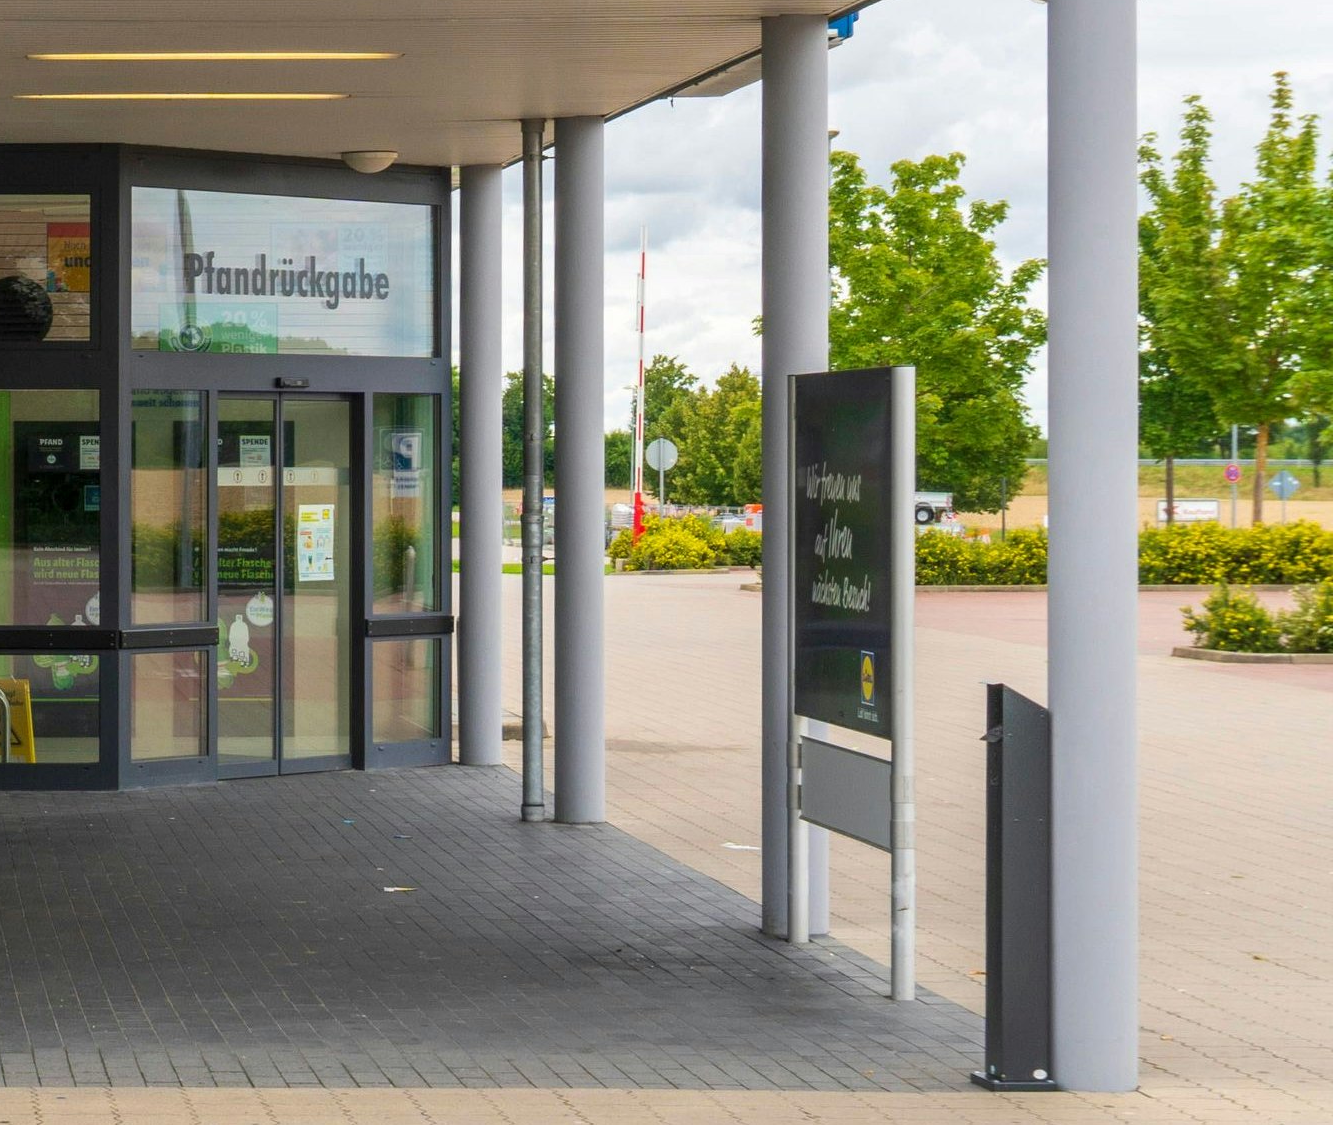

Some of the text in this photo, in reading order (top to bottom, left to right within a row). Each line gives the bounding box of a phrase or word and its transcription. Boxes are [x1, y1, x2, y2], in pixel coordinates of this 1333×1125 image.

[187, 251, 390, 309] Pfandrückgabe
[221, 310, 268, 328] 20 %
[221, 343, 267, 354] Plastik
[39, 438, 63, 446] PFAND
[81, 438, 100, 446] SPEN
[241, 438, 268, 446] SPENDE
[806, 461, 862, 506] Wir freuen uns
[34, 557, 100, 568] Aus alter Flasc
[218, 558, 272, 568] lter Flasche
[34, 568, 100, 579] wird neue Flas
[218, 570, 239, 579] neue
[811, 569, 871, 612] nächsten Besuch!
